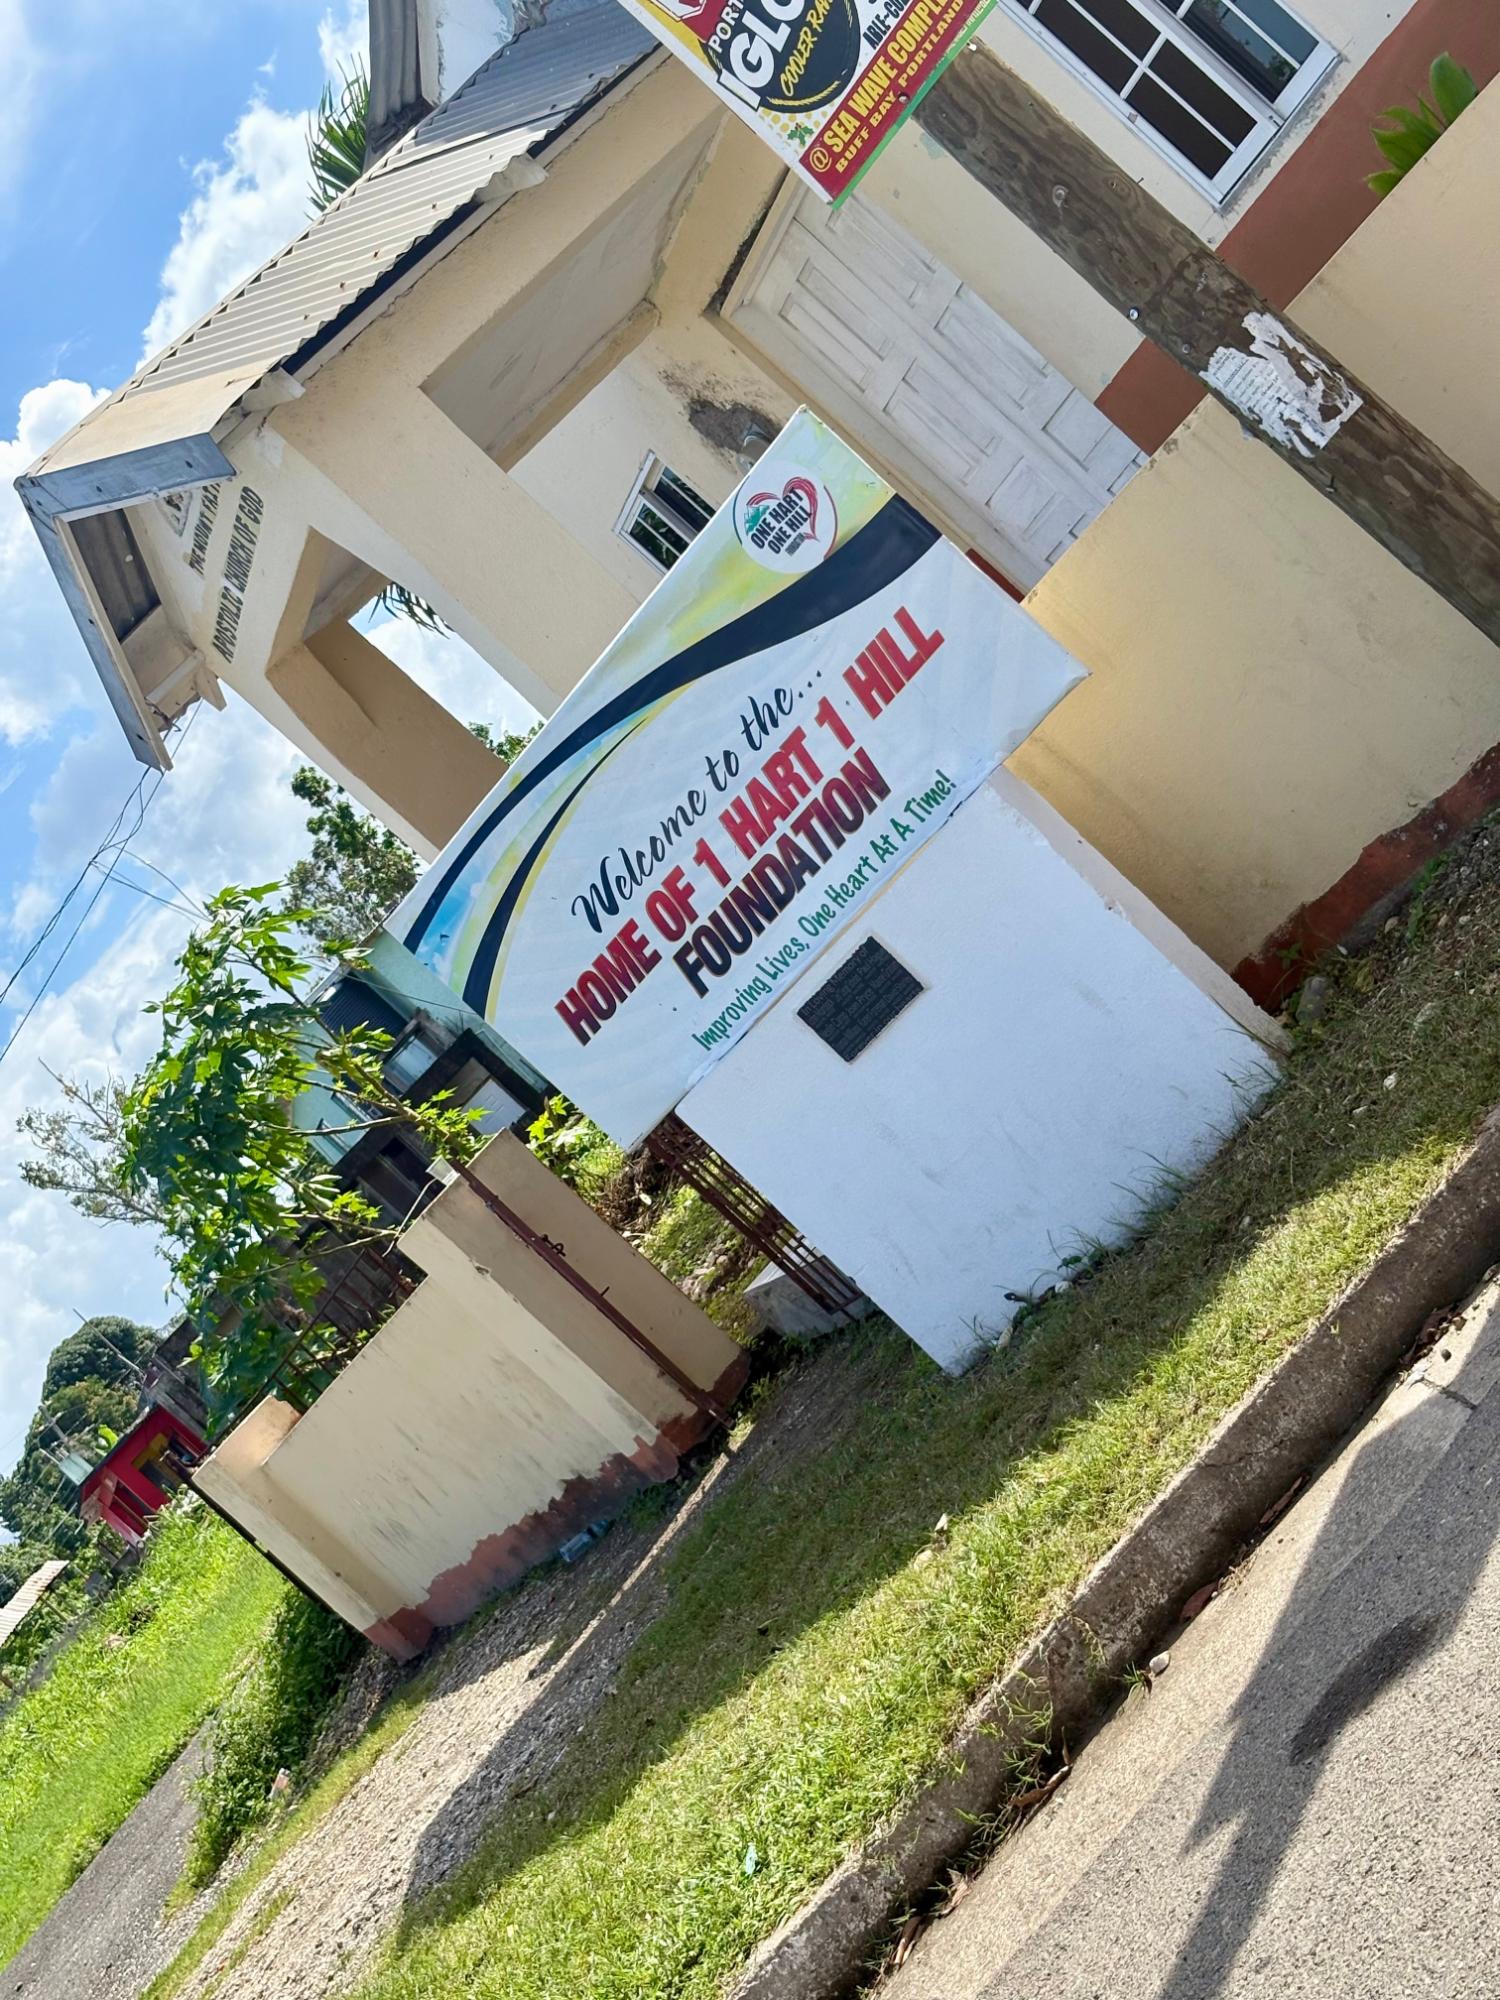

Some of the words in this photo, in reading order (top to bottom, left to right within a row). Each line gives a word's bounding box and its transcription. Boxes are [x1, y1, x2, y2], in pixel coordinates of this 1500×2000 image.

[708, 0, 745, 53] PORT
[779, 27, 818, 97] COOLER
[835, 121, 872, 173] BUFF
[899, 0, 965, 88] PORTLAND
[809, 147, 833, 173] @
[823, 113, 861, 155] SEA
[848, 56, 898, 115] WAVE
[193, 511, 213, 554] MOUNT
[233, 514, 257, 546] OF
[238, 486, 264, 525] GOD
[751, 517, 776, 549] ONE
[768, 487, 803, 524] HART
[768, 526, 792, 554] ONE
[784, 505, 812, 533] HILL
[189, 548, 206, 576] THE
[224, 536, 255, 593] CHURCH
[212, 586, 243, 664] APOSTOLIC
[554, 918, 663, 1047] HOME
[645, 865, 699, 942] OF
[693, 837, 732, 888] 1
[718, 725, 824, 860] HART
[814, 696, 855, 751] 1
[842, 606, 945, 719] HILL
[571, 788, 706, 933] Welcome
[706, 749, 740, 792] to
[672, 747, 892, 999] FOUNDATION
[691, 973, 773, 1051] Improving
[756, 935, 811, 981] Lives,
[798, 902, 836, 937] One
[824, 855, 879, 909] Heart
[869, 834, 900, 863] At
[889, 817, 915, 842] A
[904, 769, 957, 823] Time!
